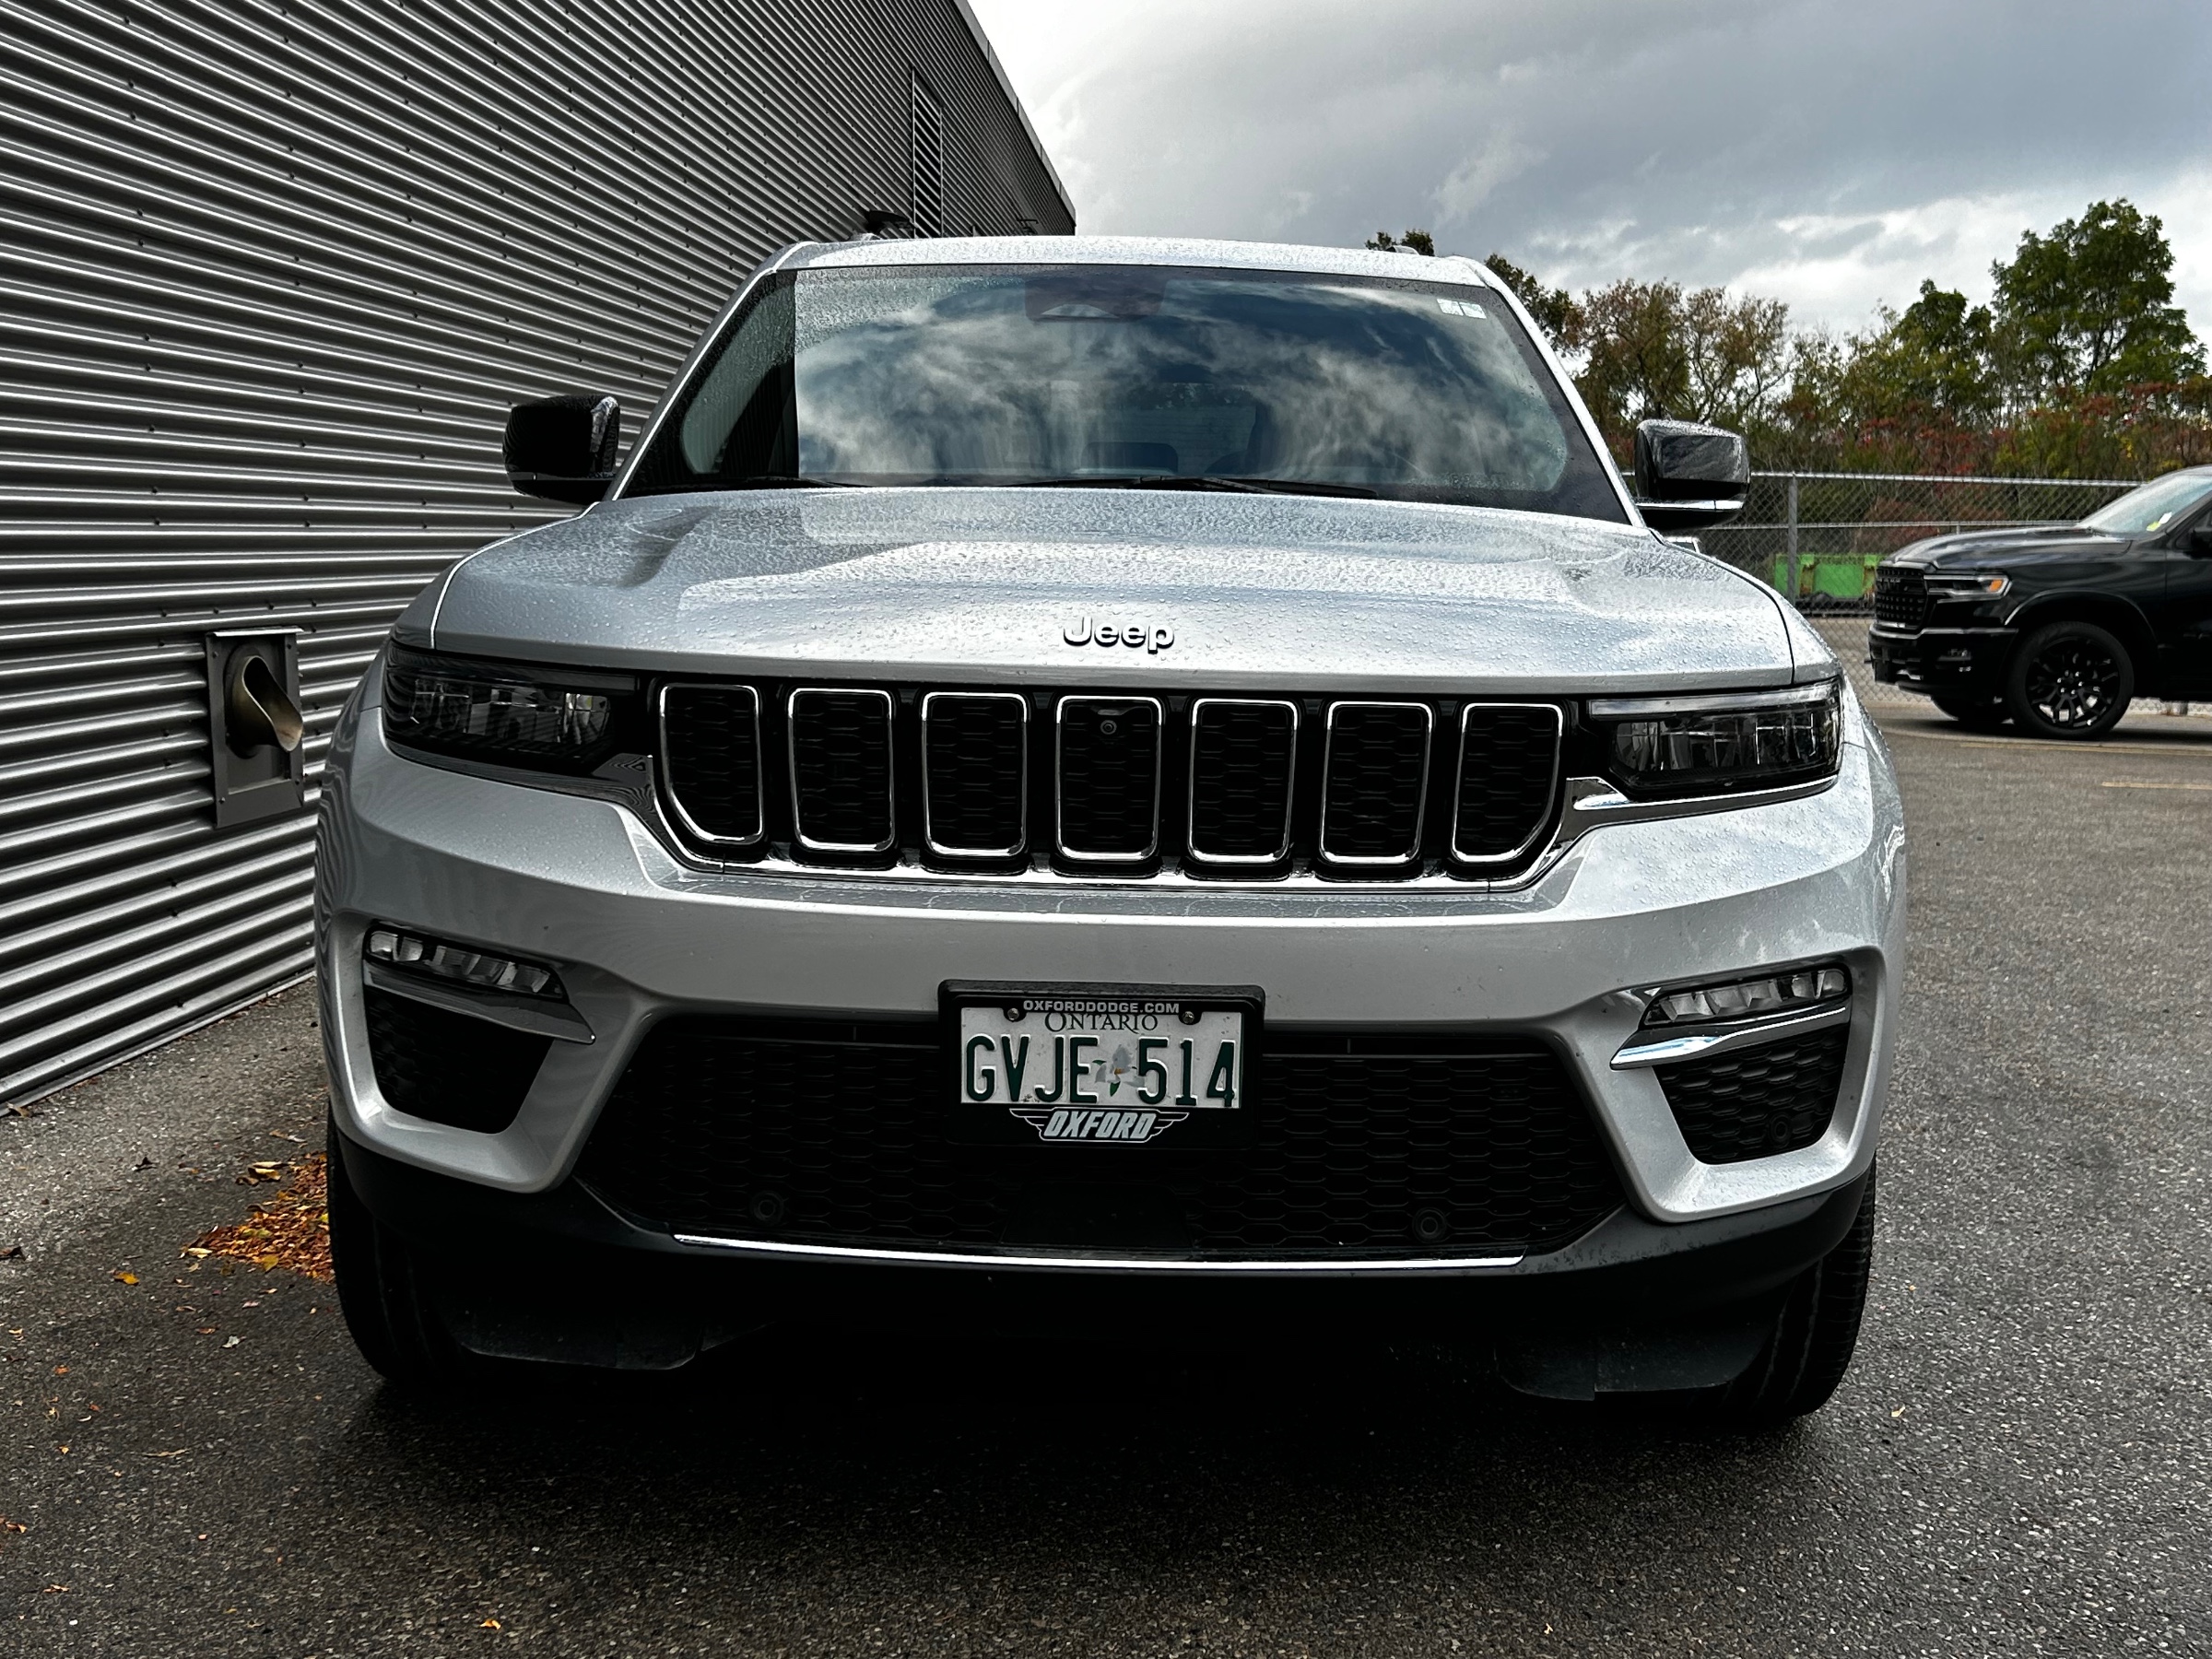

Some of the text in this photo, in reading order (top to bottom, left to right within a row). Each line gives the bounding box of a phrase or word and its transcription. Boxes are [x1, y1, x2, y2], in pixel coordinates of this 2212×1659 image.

[1063, 617, 1174, 654] Jeep
[1023, 1000, 1180, 1014] OXFORDDODGE.COM
[1044, 1013, 1159, 1034] ONTARIO
[966, 1034, 1236, 1108] GVJE 514
[1043, 1111, 1156, 1139] OXFORD
